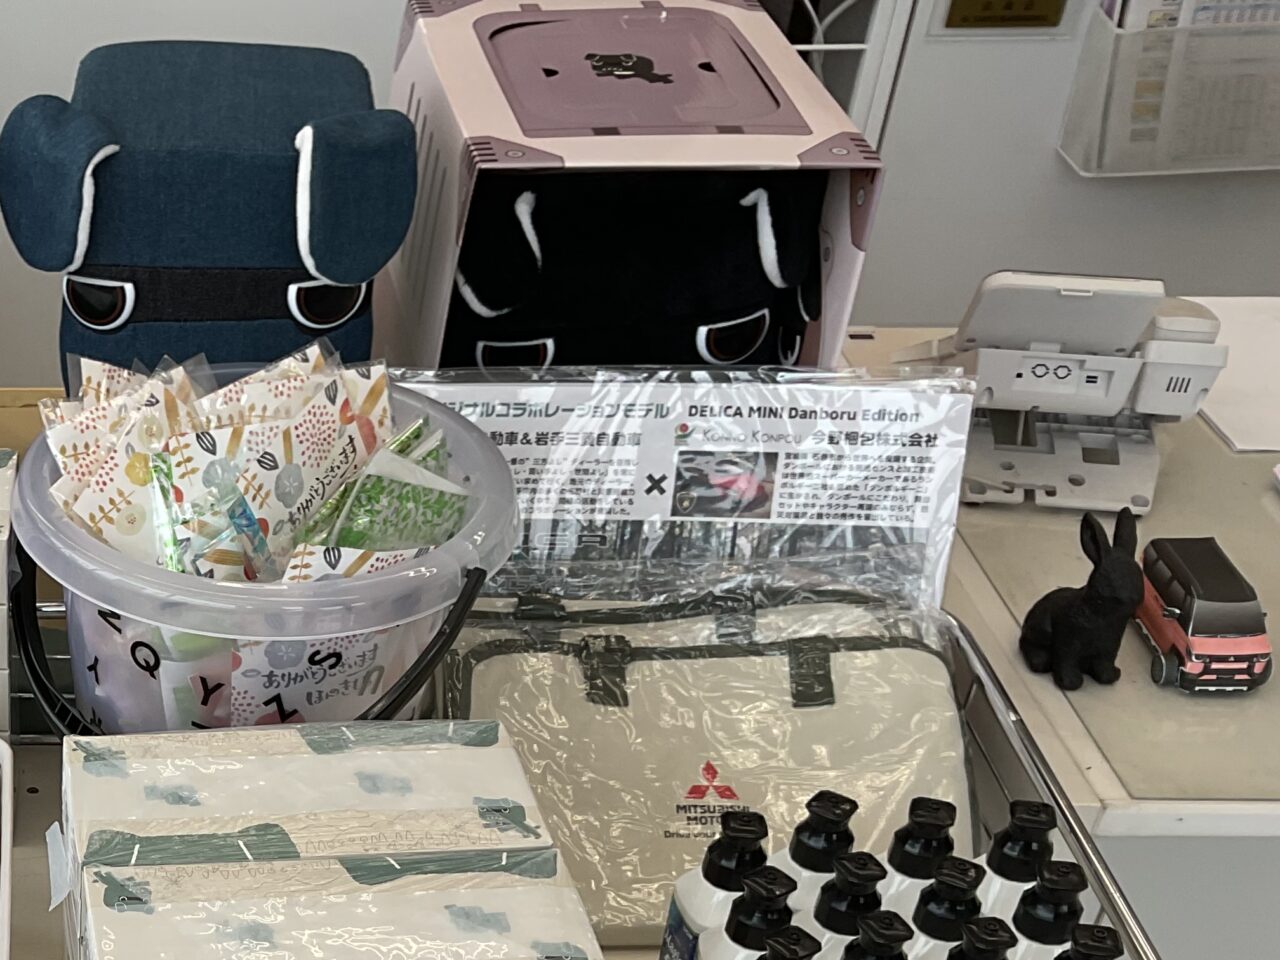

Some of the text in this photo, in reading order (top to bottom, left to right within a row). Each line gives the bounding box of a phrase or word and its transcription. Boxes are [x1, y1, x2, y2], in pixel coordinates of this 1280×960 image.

[687, 405, 920, 423] DELICA MINI Danboru Edition
[686, 815, 722, 826] MOT
